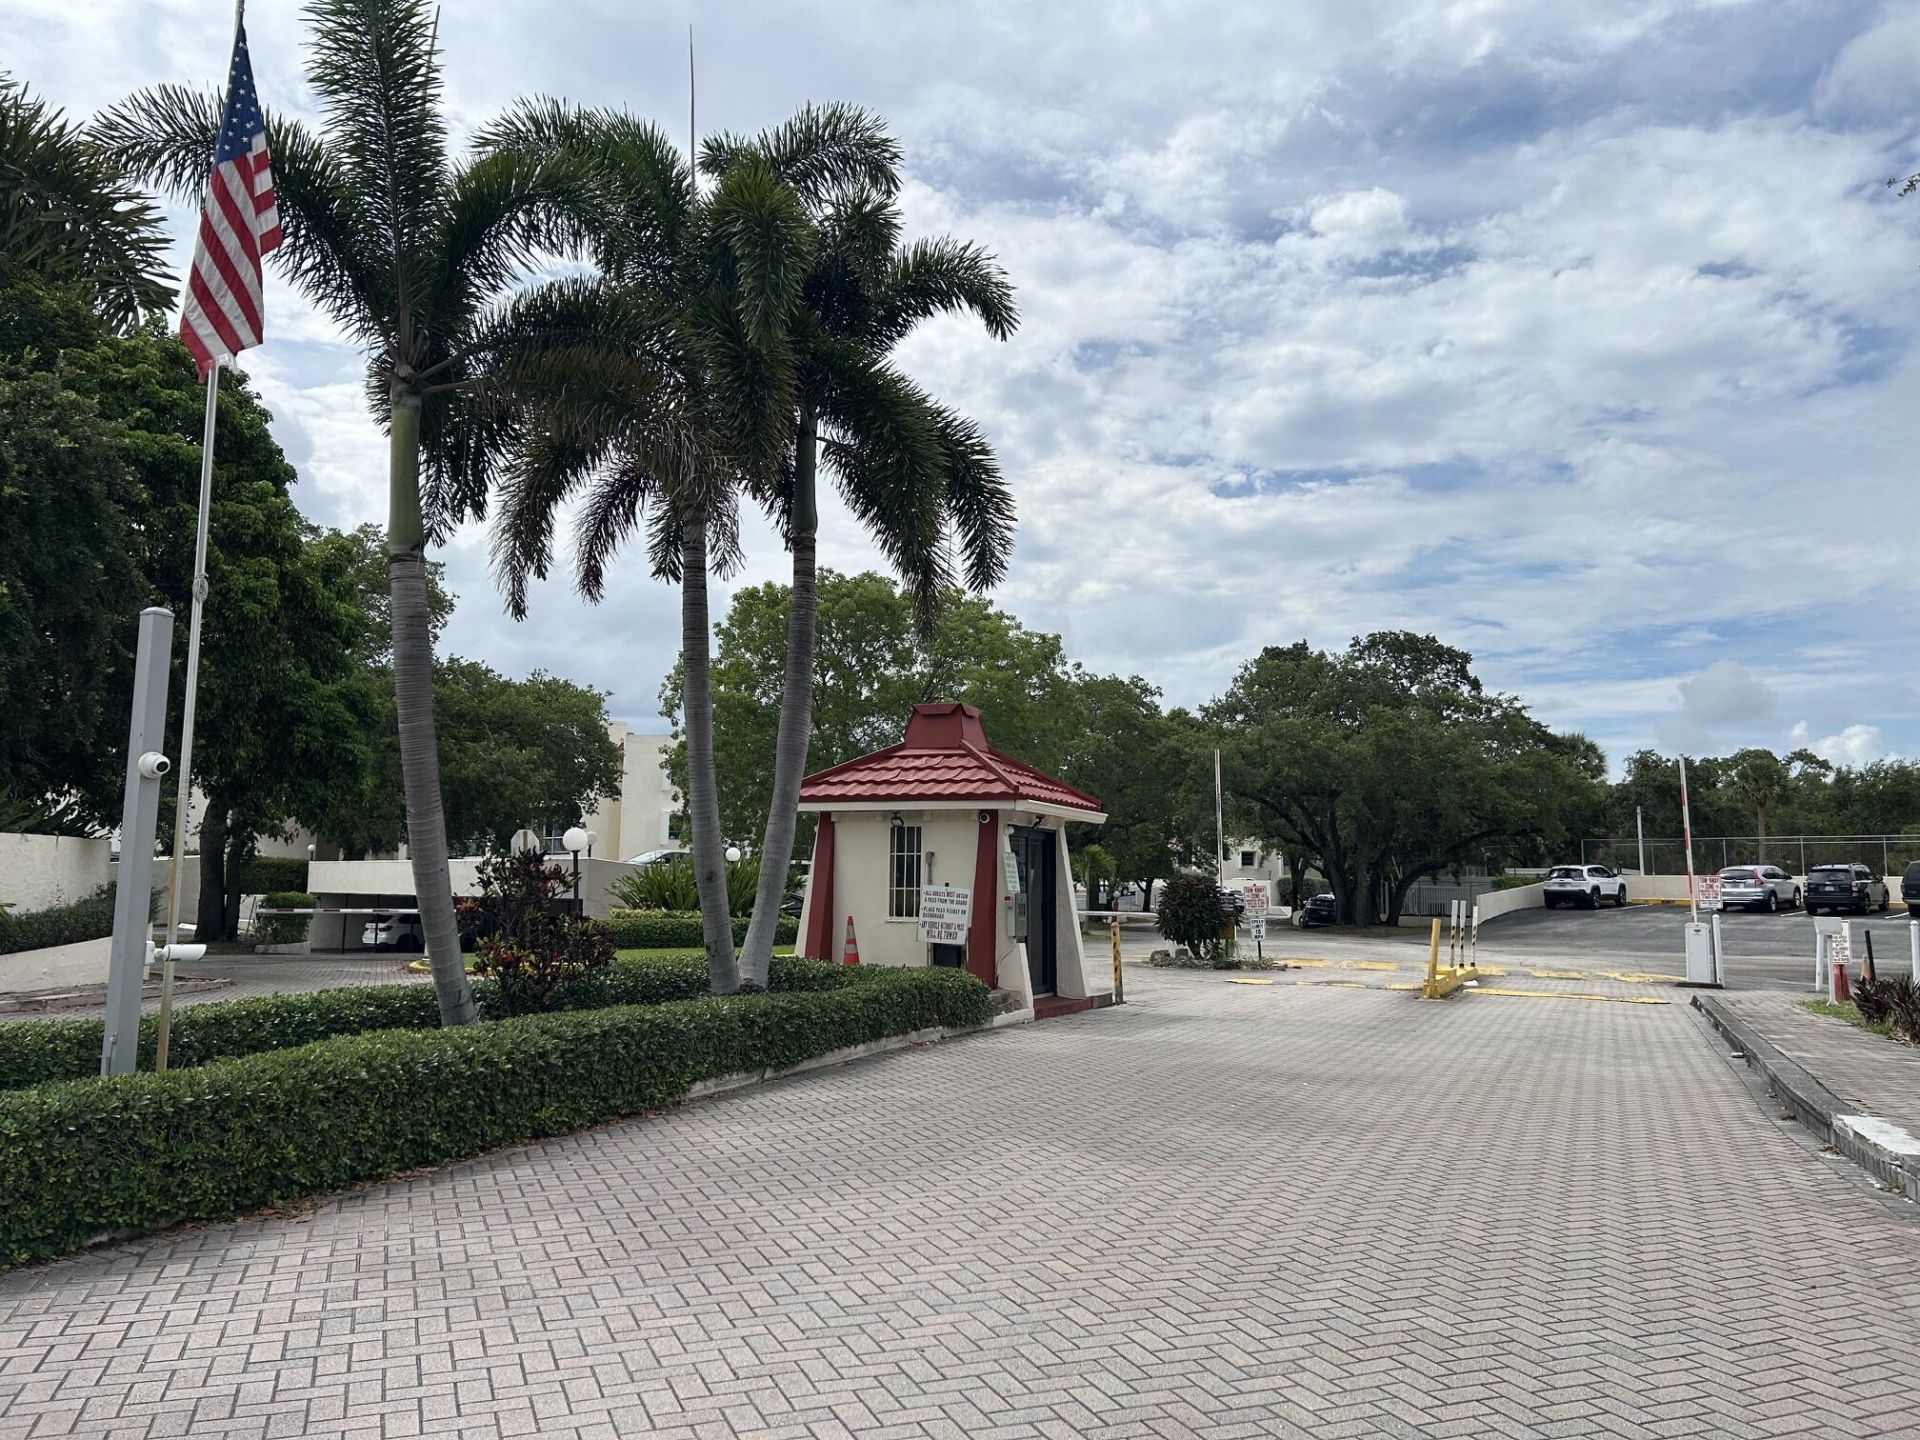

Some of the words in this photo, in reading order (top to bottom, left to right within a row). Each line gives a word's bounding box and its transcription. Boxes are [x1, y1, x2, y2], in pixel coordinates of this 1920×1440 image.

[926, 930, 936, 938] WILL
[938, 930, 942, 938] BE
[944, 931, 958, 940] TOWED
